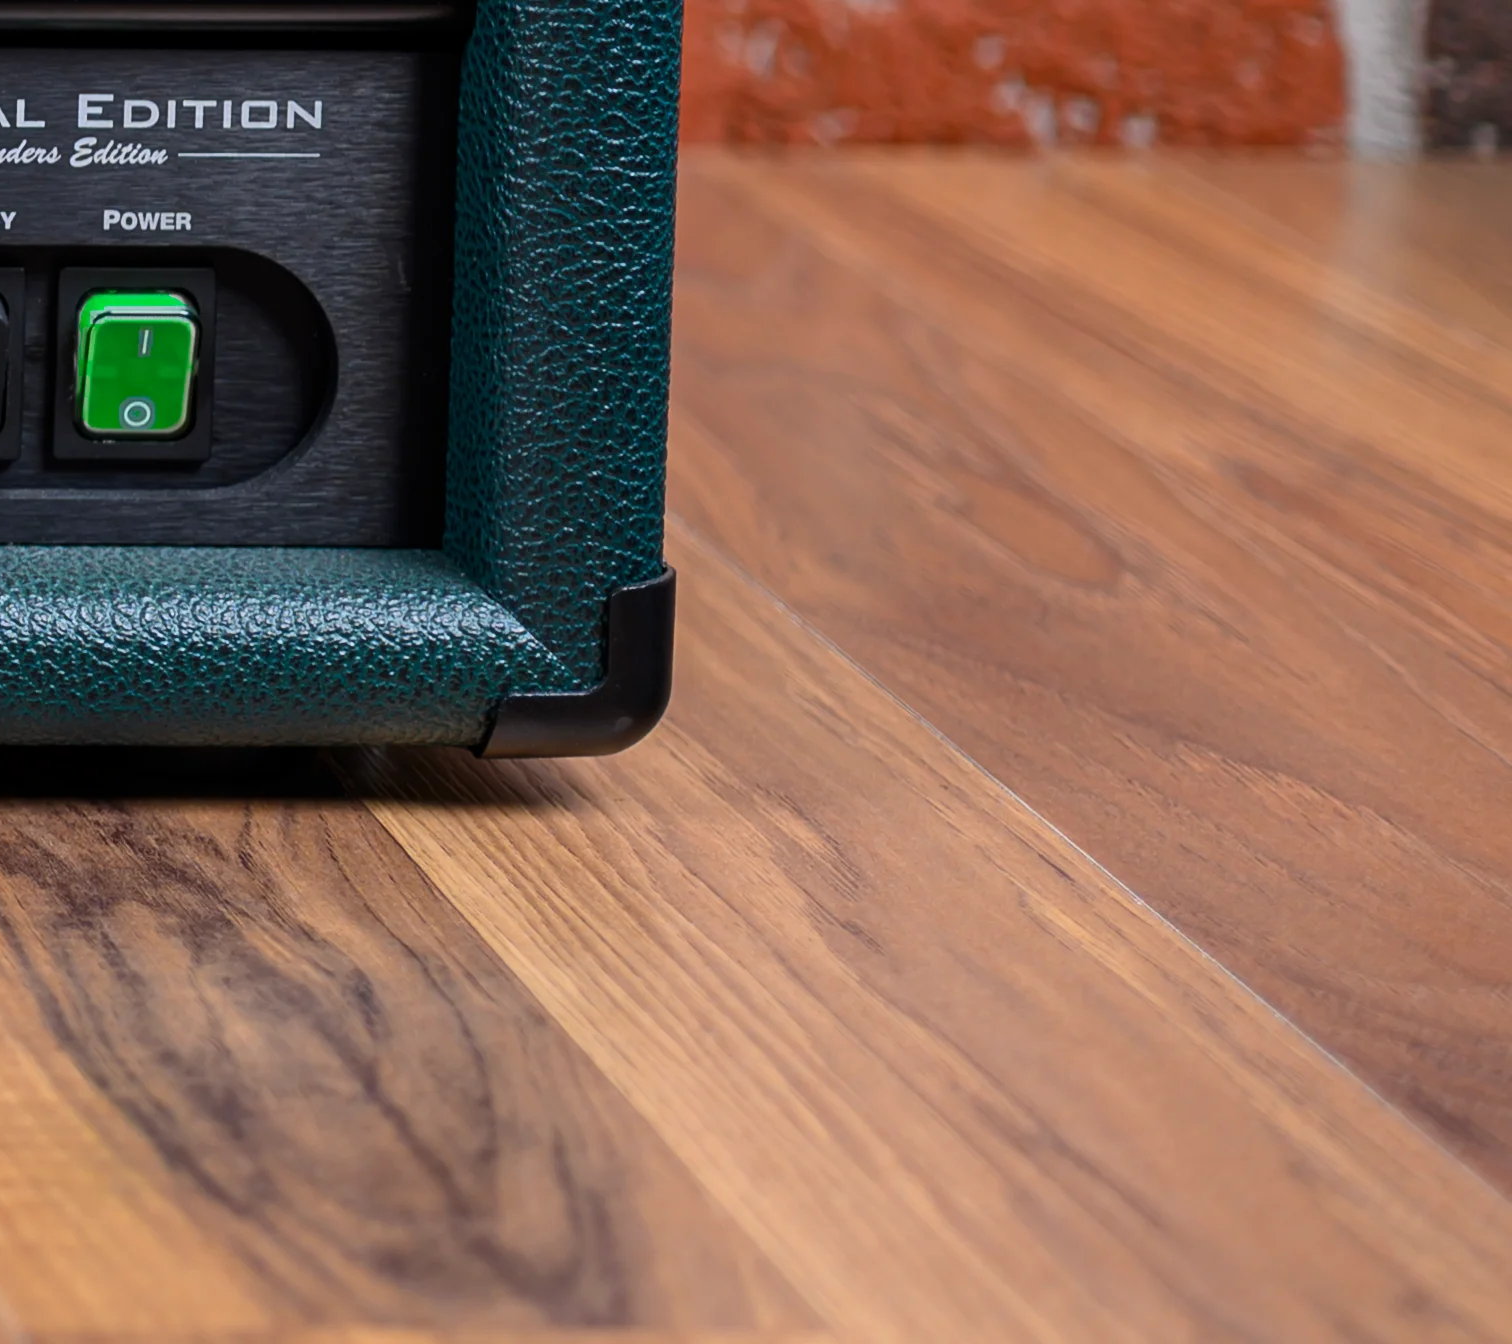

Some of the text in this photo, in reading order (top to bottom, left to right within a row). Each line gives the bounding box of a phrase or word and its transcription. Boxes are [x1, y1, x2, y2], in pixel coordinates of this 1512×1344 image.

[77, 93, 323, 129] EDITION
[69, 136, 169, 168] Edition
[103, 209, 192, 231] POWER
